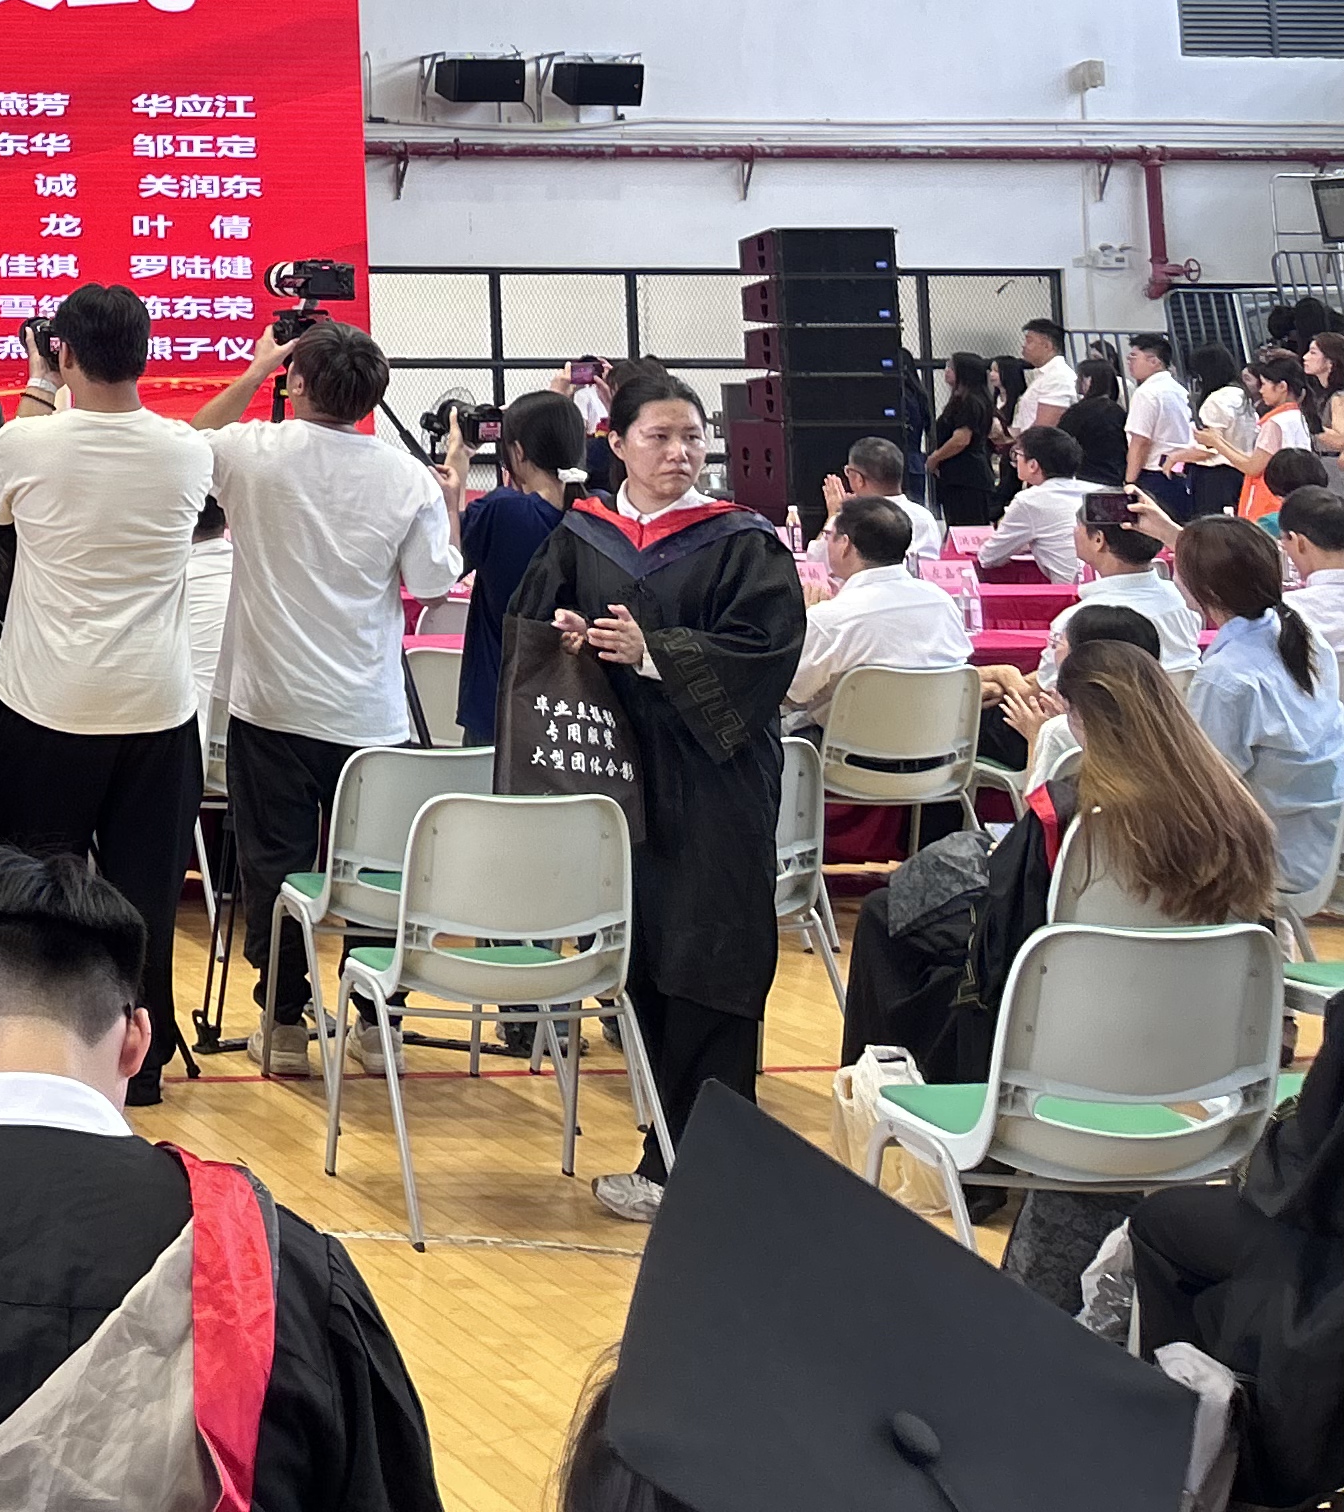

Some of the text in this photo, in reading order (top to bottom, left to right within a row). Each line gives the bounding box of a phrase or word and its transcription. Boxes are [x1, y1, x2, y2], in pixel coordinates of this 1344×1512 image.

[131, 93, 256, 118] 华应江
[133, 133, 257, 158] 邹正定
[138, 173, 262, 199] 关润东
[129, 254, 254, 280] 罗陆健
[531, 746, 634, 782] 大型团体合影
